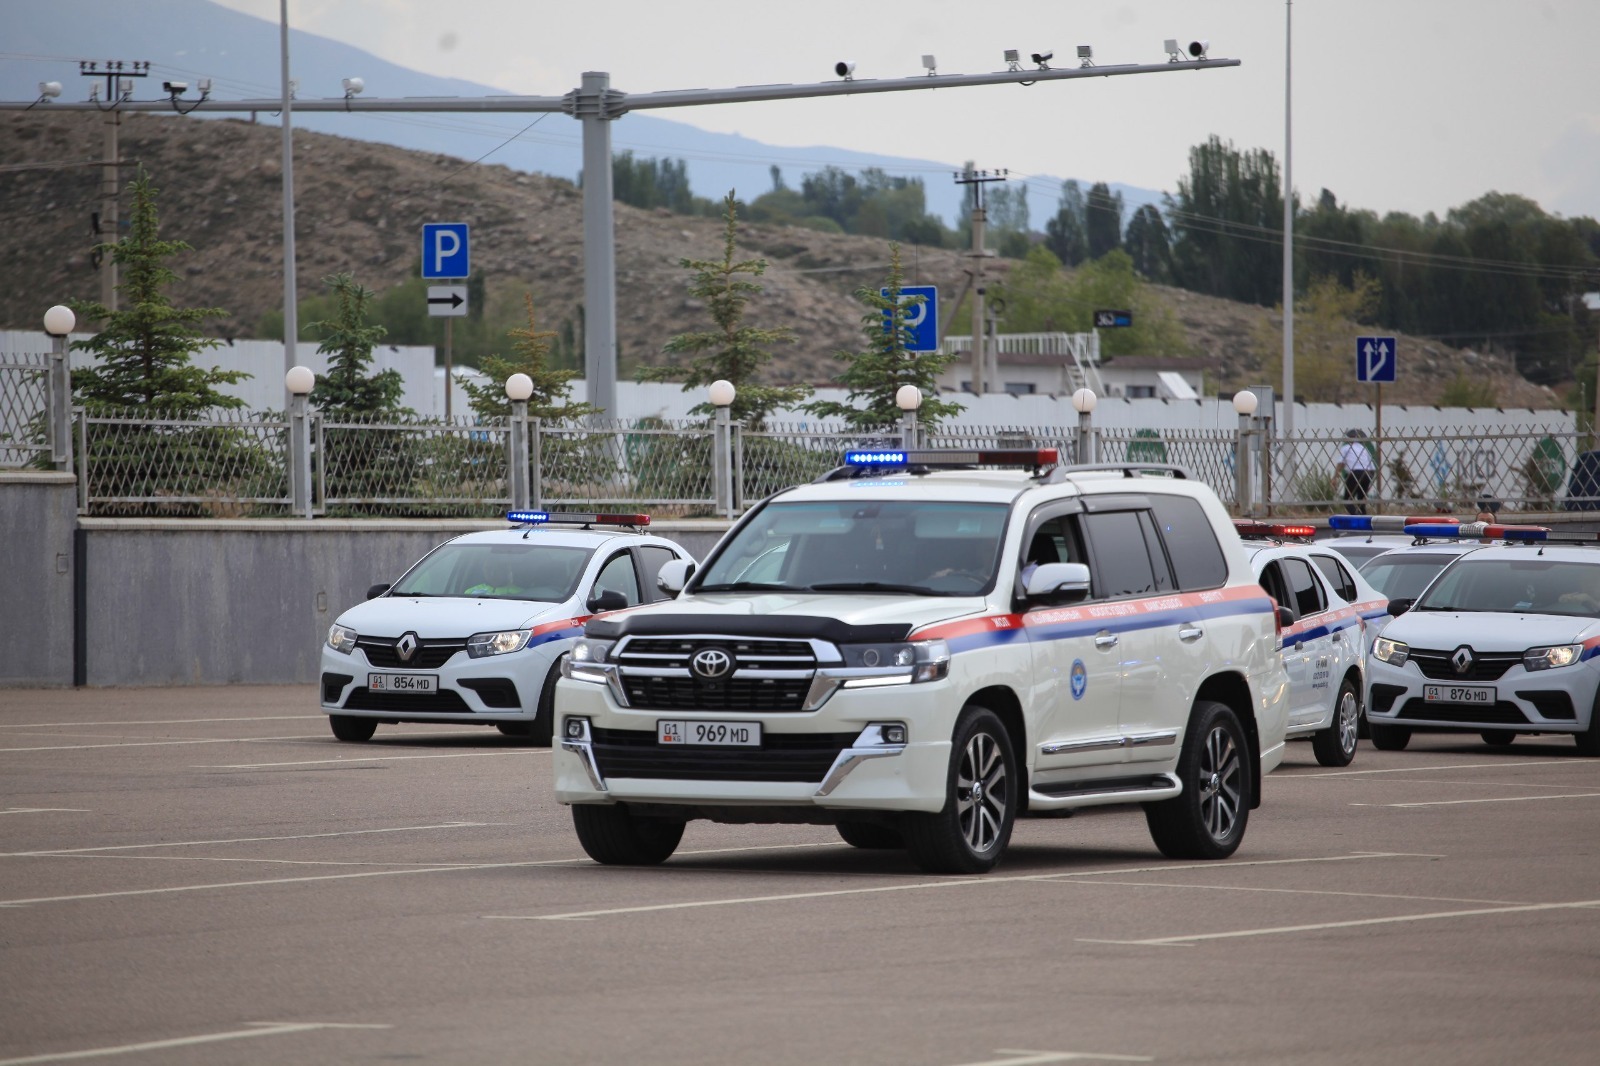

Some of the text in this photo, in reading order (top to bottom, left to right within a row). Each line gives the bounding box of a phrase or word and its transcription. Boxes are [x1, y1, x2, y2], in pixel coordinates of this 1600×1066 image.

[435, 230, 461, 272] P
[896, 294, 927, 345] P
[394, 677, 414, 689] 854
[416, 680, 429, 689] MD
[1450, 688, 1472, 701] 876
[1473, 691, 1487, 701] MD
[664, 723, 749, 743] 01 969 MD
